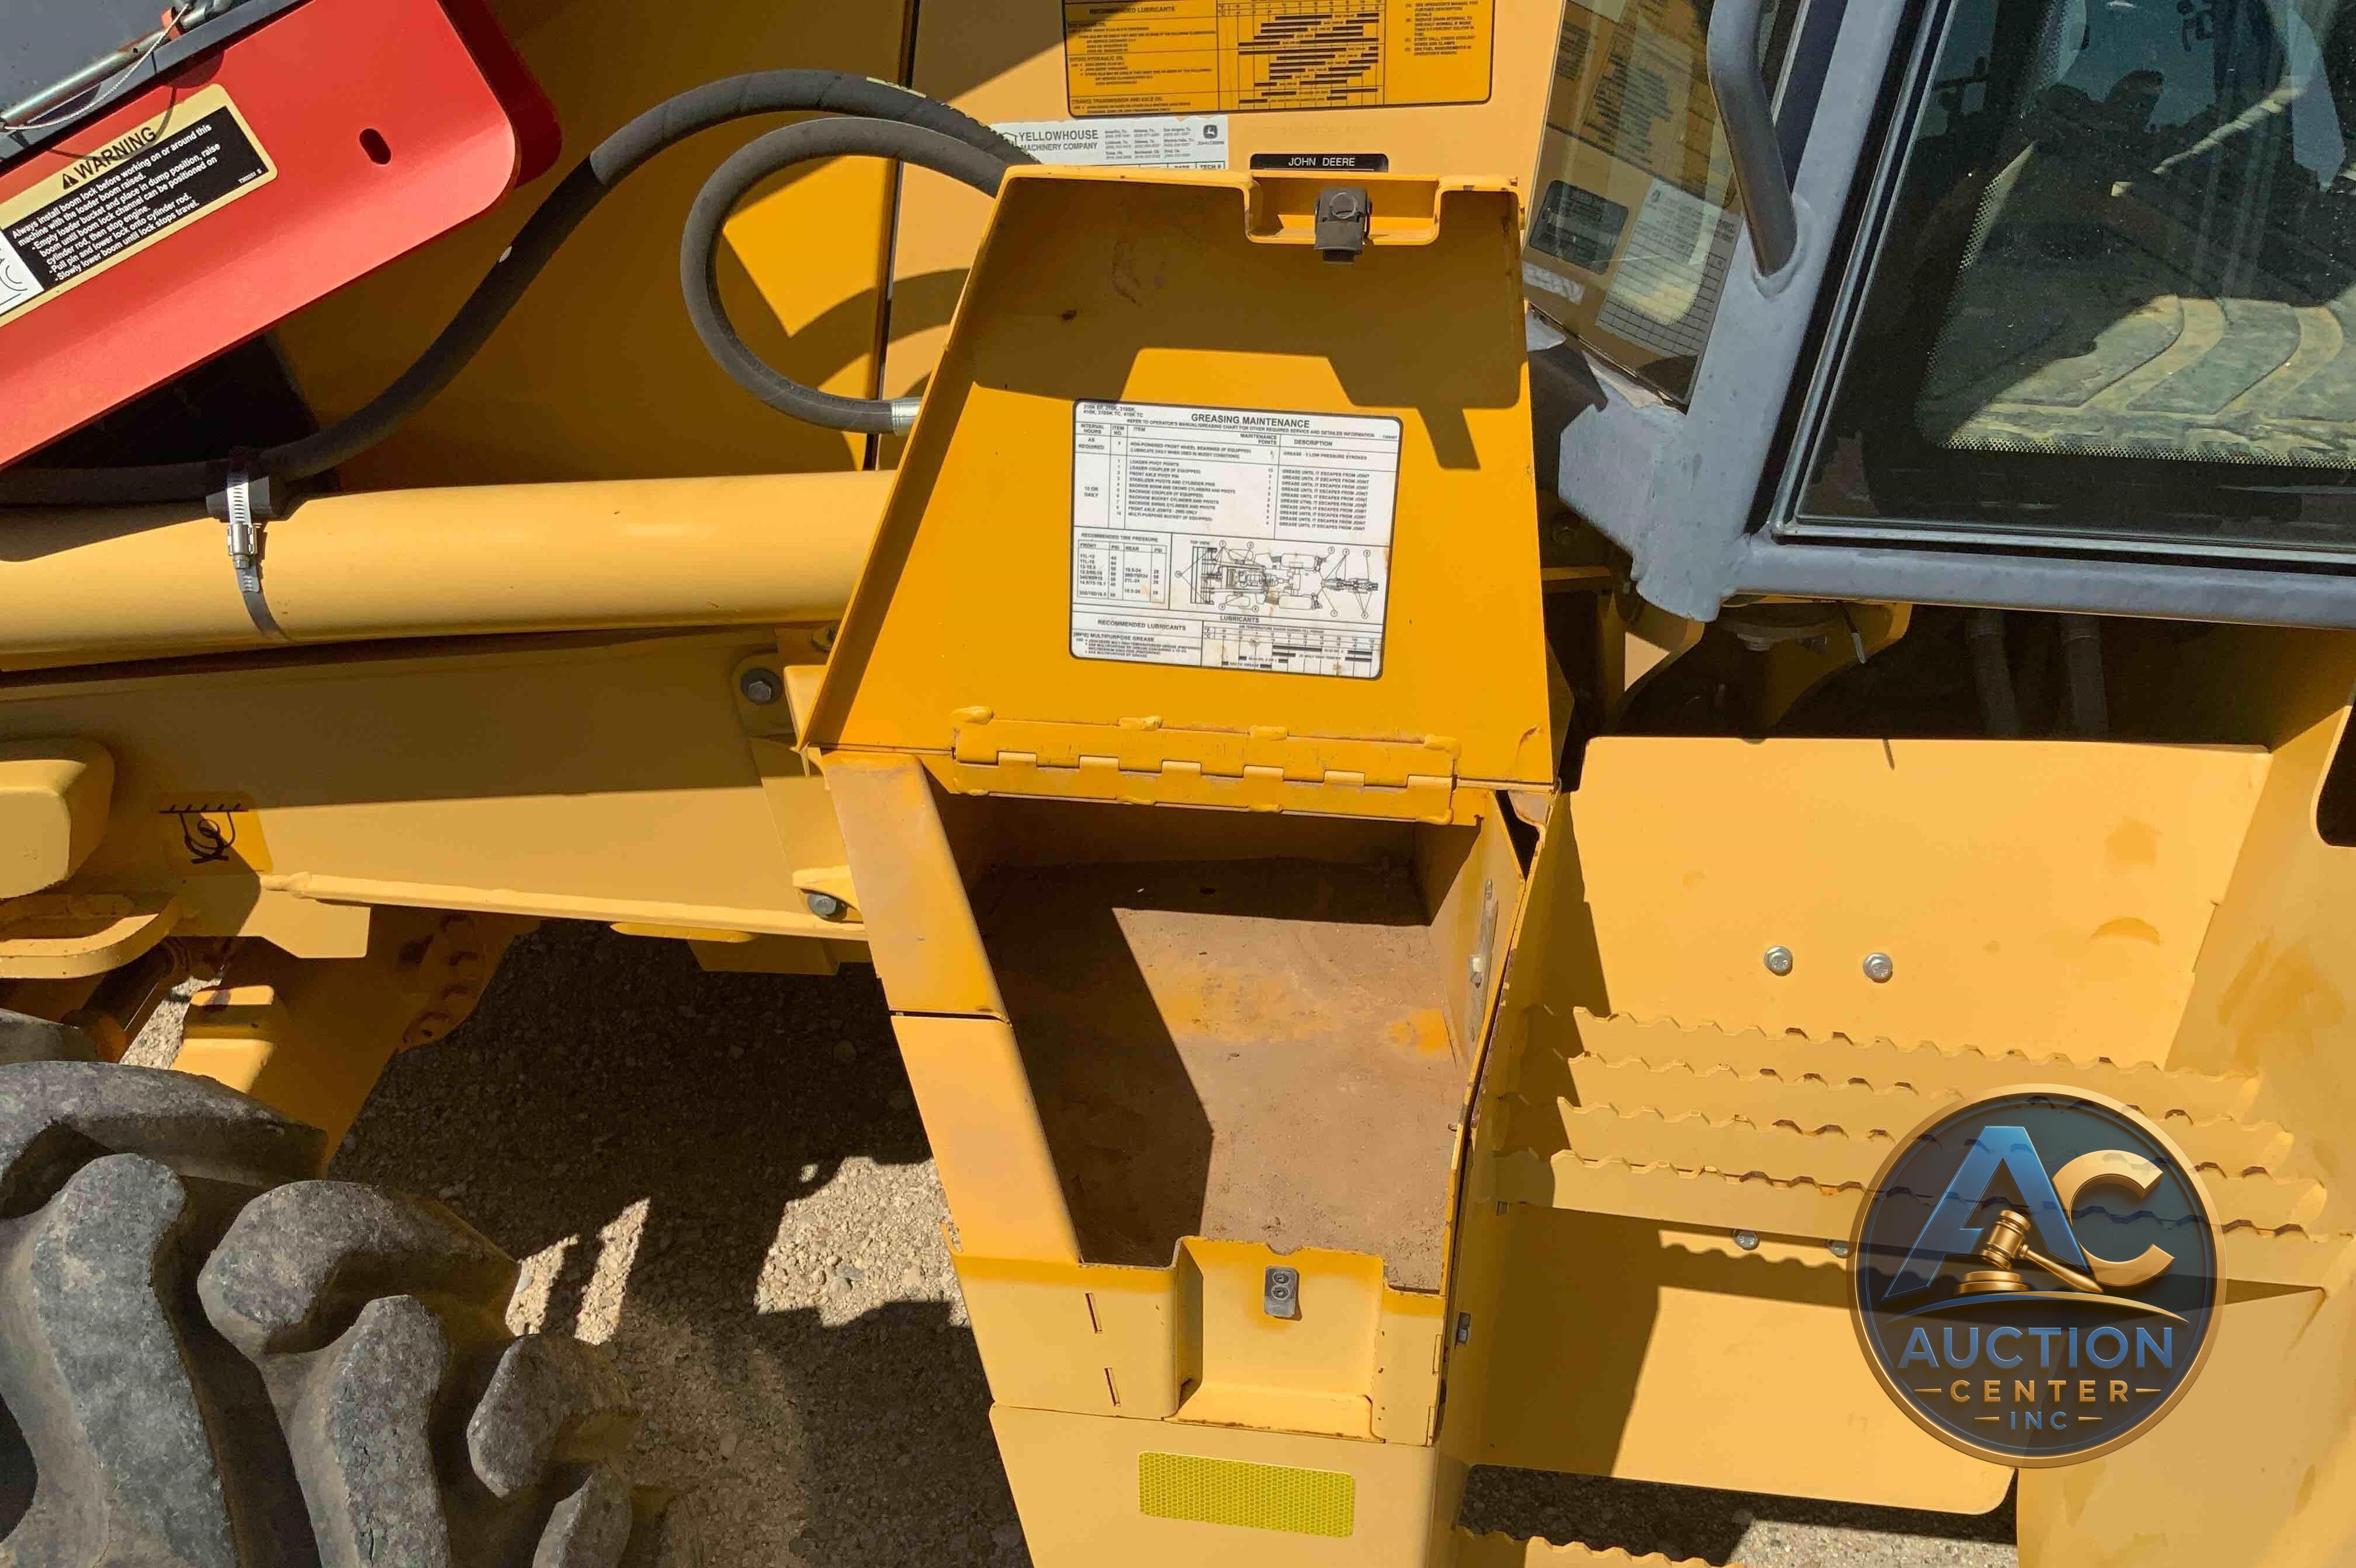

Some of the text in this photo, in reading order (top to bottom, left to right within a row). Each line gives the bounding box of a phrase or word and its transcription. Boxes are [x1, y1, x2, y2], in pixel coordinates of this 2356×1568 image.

[74, 126, 157, 179] WARNING
[1019, 130, 1099, 141] YELLOWHOUSE
[1288, 158, 1355, 166] JOHN DEERE
[12, 124, 212, 241] Always install boom lock before working on or around this
[17, 171, 146, 247] machine with the loader boom raised.
[39, 157, 217, 257] boom until boom lock channel can be positioned on
[56, 220, 81, 238] loader
[78, 206, 108, 224] bucket
[105, 196, 120, 213] and
[119, 188, 140, 204] place
[138, 183, 149, 192] in
[148, 171, 169, 188] dump
[200, 143, 220, 158] raise
[46, 245, 74, 266] cylinder
[88, 228, 109, 241] then
[106, 219, 123, 233] stop
[123, 206, 151, 223] engine.
[65, 255, 79, 266] pin
[78, 245, 93, 258] and
[91, 235, 113, 250] lower
[112, 226, 130, 240] lock
[129, 217, 147, 230] onto
[146, 201, 175, 221] cylinder
[175, 192, 192, 205] rod.
[79, 252, 101, 268] lower
[99, 241, 123, 256] boom
[122, 231, 140, 245] until
[137, 223, 156, 236] lock
[155, 212, 176, 227] stops
[175, 199, 200, 216] travel.
[1191, 413, 1309, 428] GREASING MAINTENANCE
[1097, 619, 1186, 631] RECOMMENDED LUBRICANTS
[1219, 615, 1259, 623] LUBRICANTS
